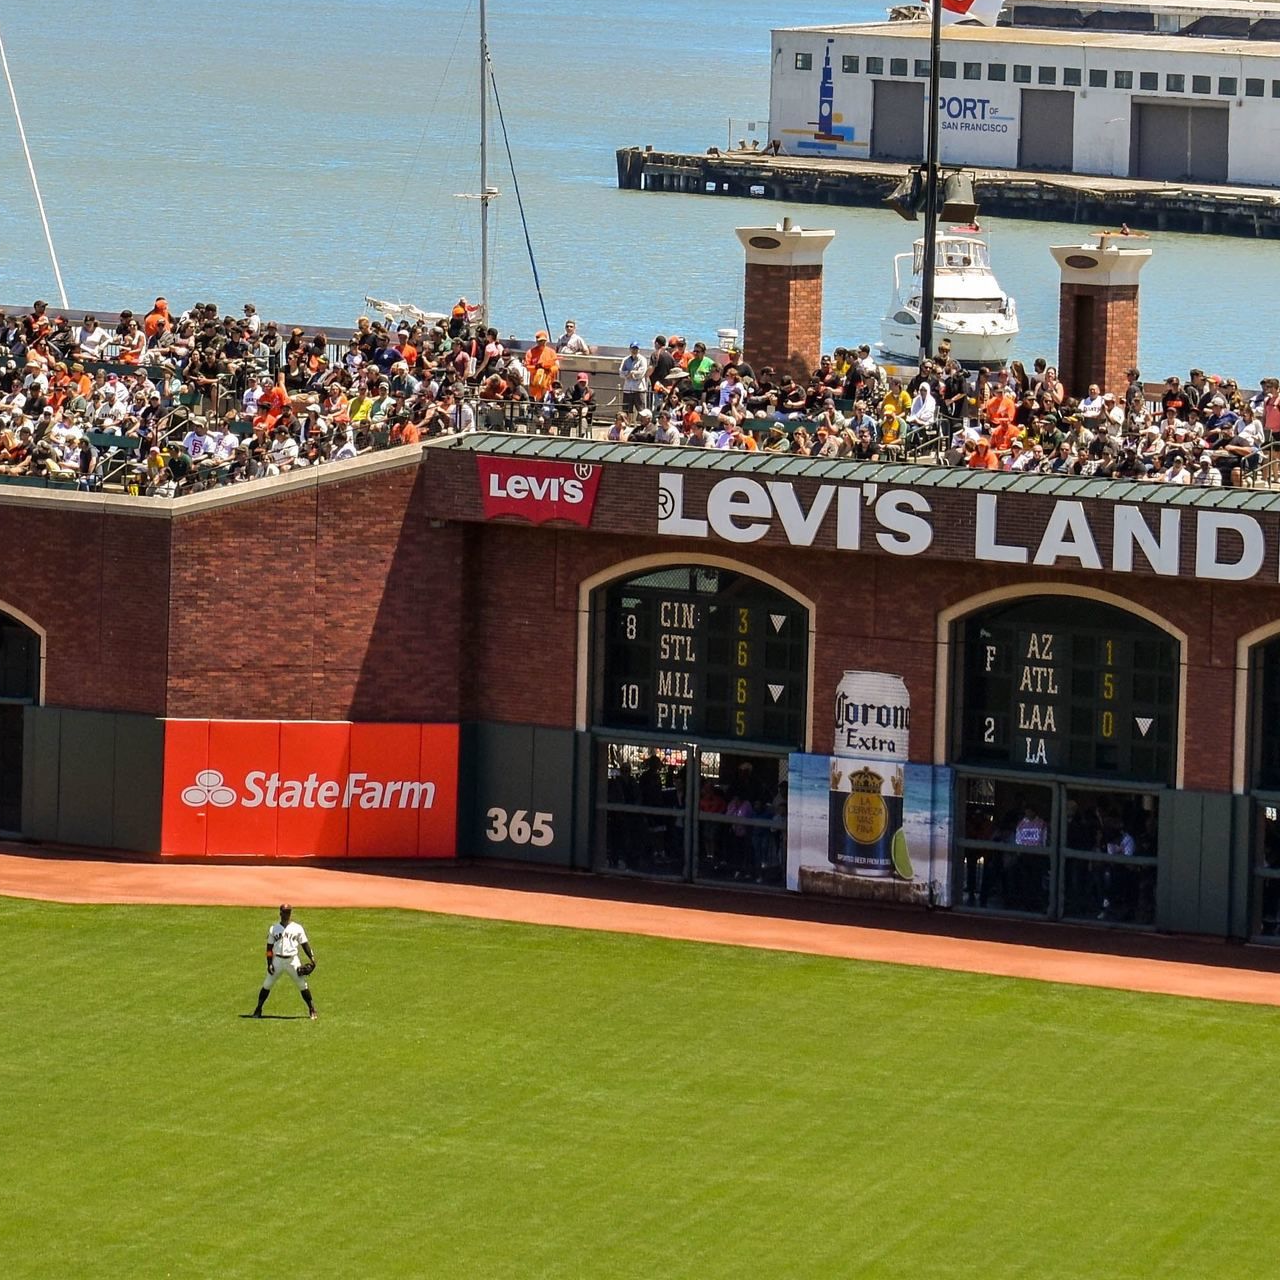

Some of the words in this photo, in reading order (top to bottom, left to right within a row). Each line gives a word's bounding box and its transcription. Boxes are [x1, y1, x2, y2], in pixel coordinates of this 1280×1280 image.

[939, 96, 990, 120] PORT
[989, 107, 999, 115] OF
[941, 121, 959, 131] SAN
[960, 122, 1008, 133] FRANCISCO
[625, 614, 637, 640] 8
[660, 601, 696, 629] CIN
[738, 608, 749, 634] 3
[660, 634, 696, 663] STL
[737, 640, 748, 667] 6
[985, 646, 997, 672] F
[1026, 633, 1053, 661] AZ
[1105, 640, 1114, 666] 1
[621, 684, 639, 710] 10
[657, 670, 694, 700] MIL
[736, 677, 747, 704] 6
[1020, 666, 1059, 695] ATL
[1103, 674, 1114, 700] 5
[657, 702, 693, 731] PIT
[735, 710, 746, 737] 5
[984, 717, 995, 744] 2
[1019, 703, 1057, 733] LAA
[1102, 711, 1113, 738] 0
[846, 727, 896, 753] Extra
[1025, 737, 1048, 765] LA
[486, 806, 555, 847] 365
